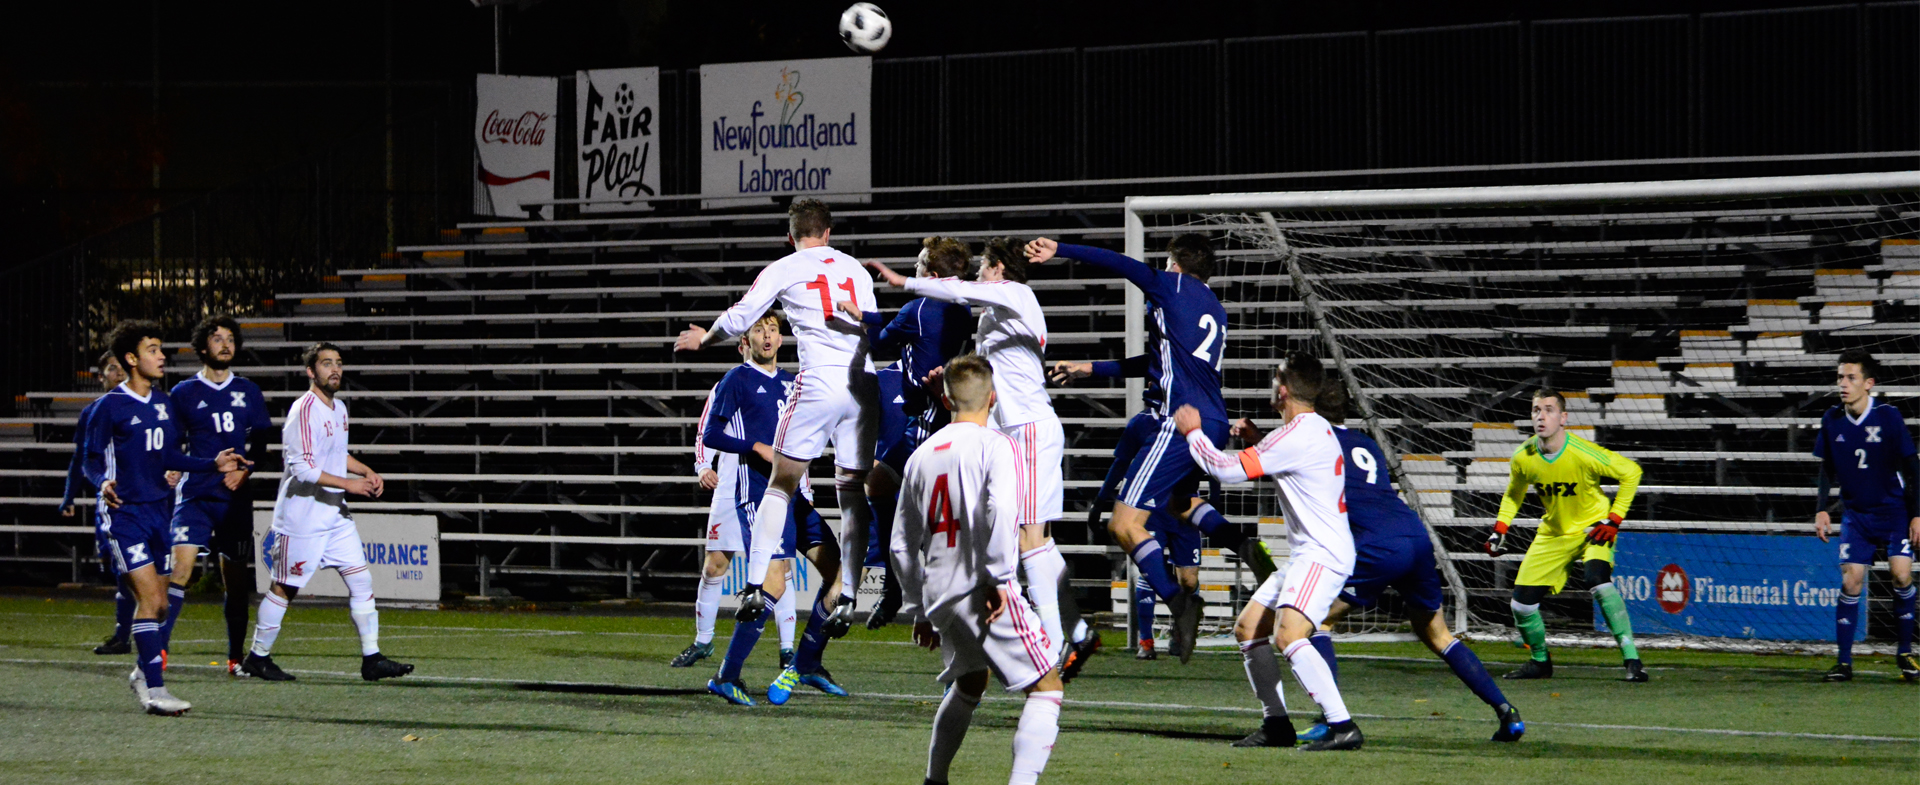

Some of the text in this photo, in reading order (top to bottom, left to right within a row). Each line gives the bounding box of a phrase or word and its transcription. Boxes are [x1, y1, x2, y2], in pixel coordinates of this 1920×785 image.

[583, 80, 652, 146] FAIR
[713, 100, 857, 156] Newfoundland
[739, 154, 831, 193] Labrador
[806, 274, 859, 321] 11
[211, 411, 235, 433] 18
[145, 427, 164, 451] 10
[1351, 447, 1377, 485] 9
[1855, 448, 1869, 469] 2
[1534, 482, 1578, 497] StFX
[928, 473, 961, 548] 4
[1192, 548, 1200, 563] 3
[1901, 538, 1911, 554] 2
[396, 570, 423, 581] LIMITED
[1610, 575, 1840, 607] MO Financial Grou
